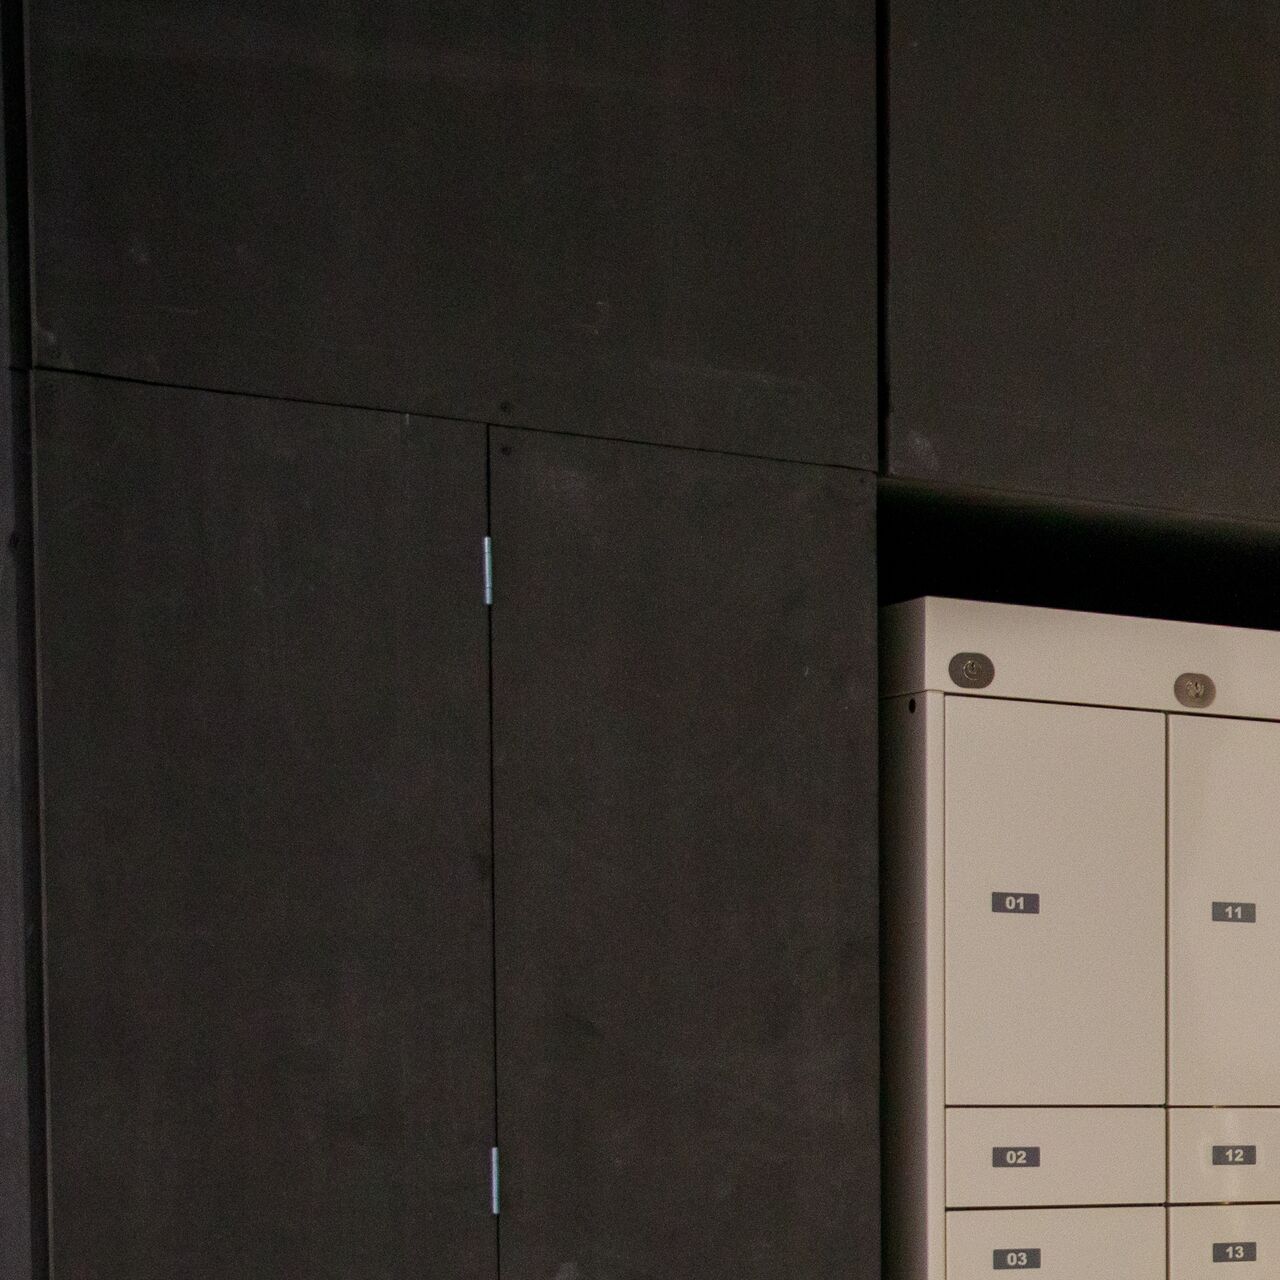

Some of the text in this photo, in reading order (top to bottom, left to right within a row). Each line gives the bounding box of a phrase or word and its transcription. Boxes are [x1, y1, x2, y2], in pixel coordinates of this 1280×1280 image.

[1005, 896, 1024, 910] 01
[1225, 906, 1242, 919] 11
[1006, 1150, 1027, 1164] 02
[1225, 1149, 1244, 1162] 12
[1007, 1252, 1027, 1266] 03
[1226, 1246, 1244, 1259] 13
